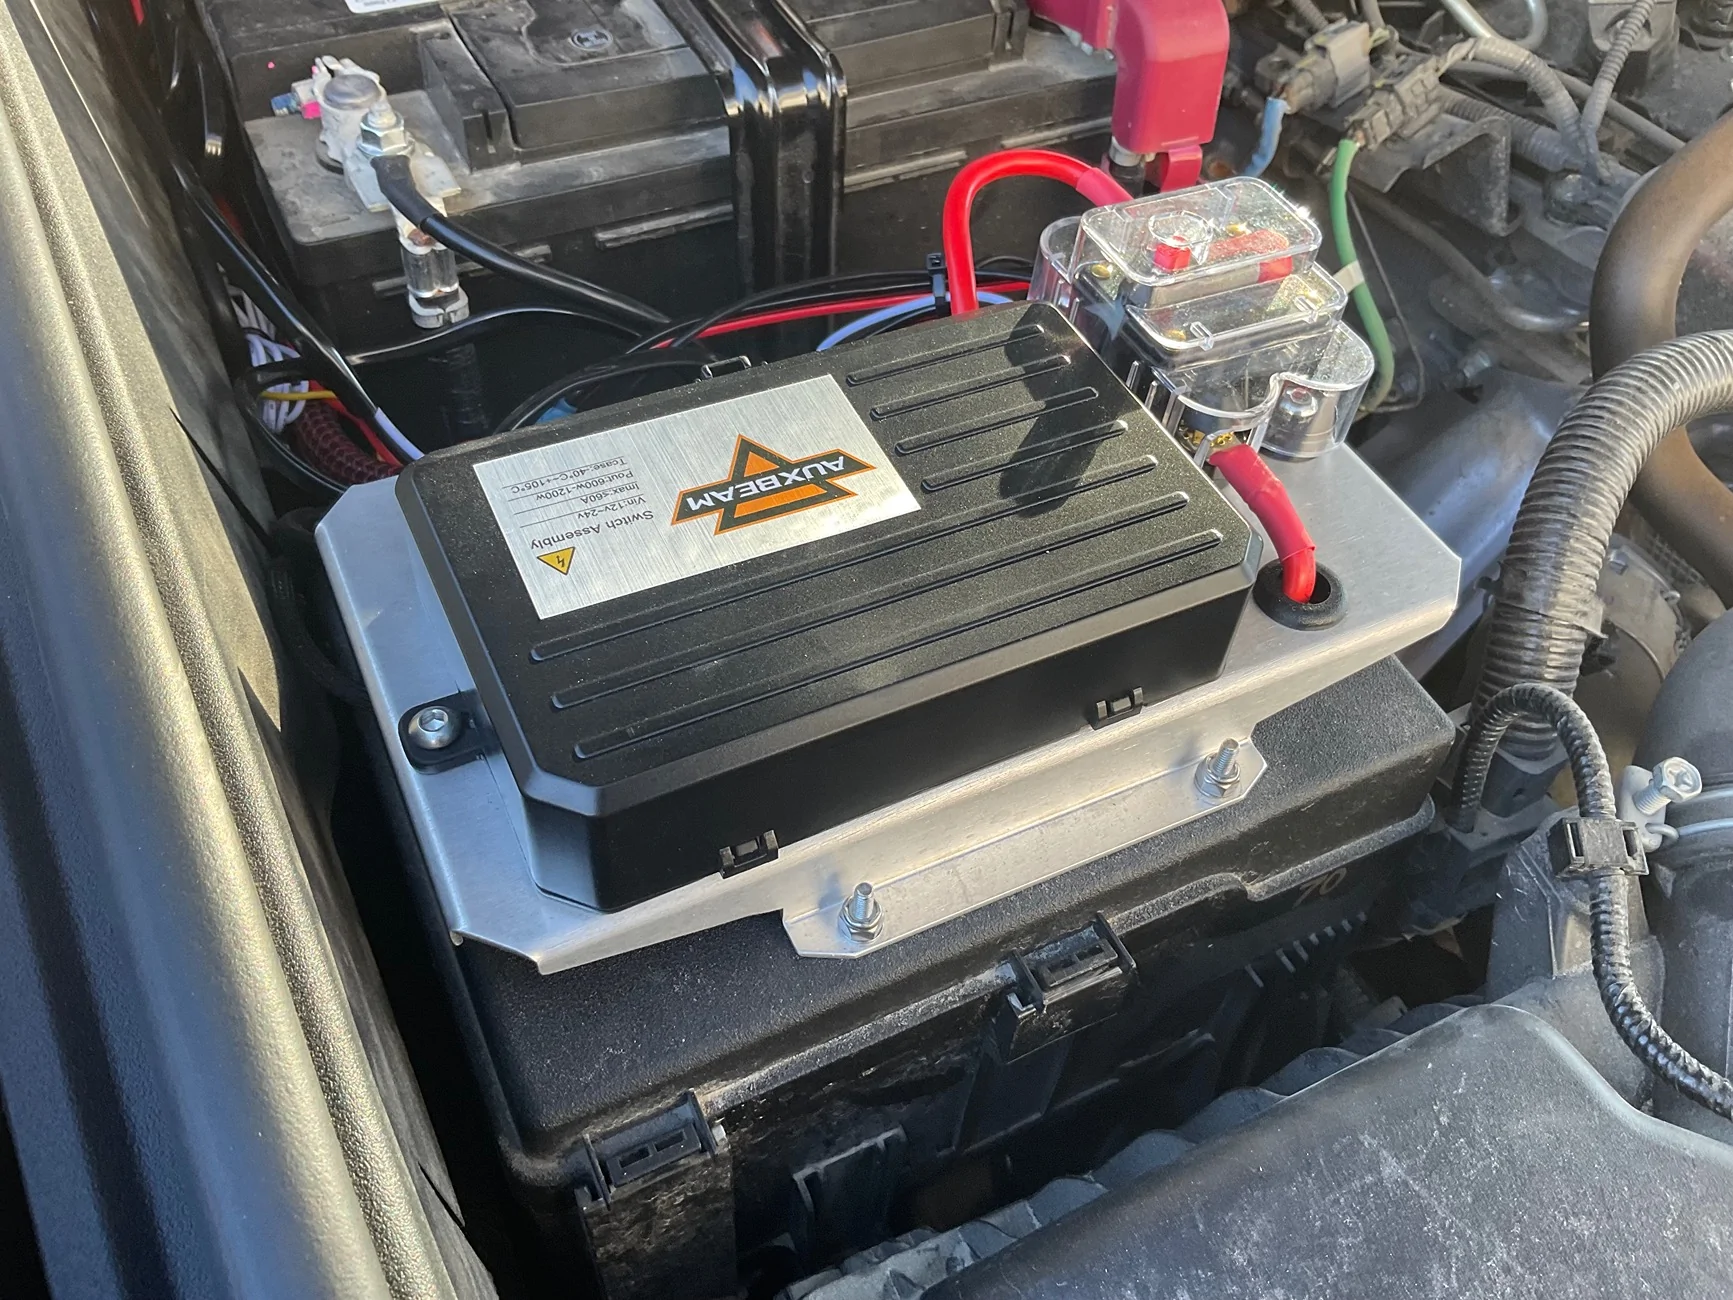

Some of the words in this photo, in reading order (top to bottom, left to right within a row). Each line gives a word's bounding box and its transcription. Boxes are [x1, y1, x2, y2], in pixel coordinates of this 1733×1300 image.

[686, 455, 845, 511] AUXBEAM
[605, 510, 654, 529] Switch
[530, 524, 601, 549] Assembly
